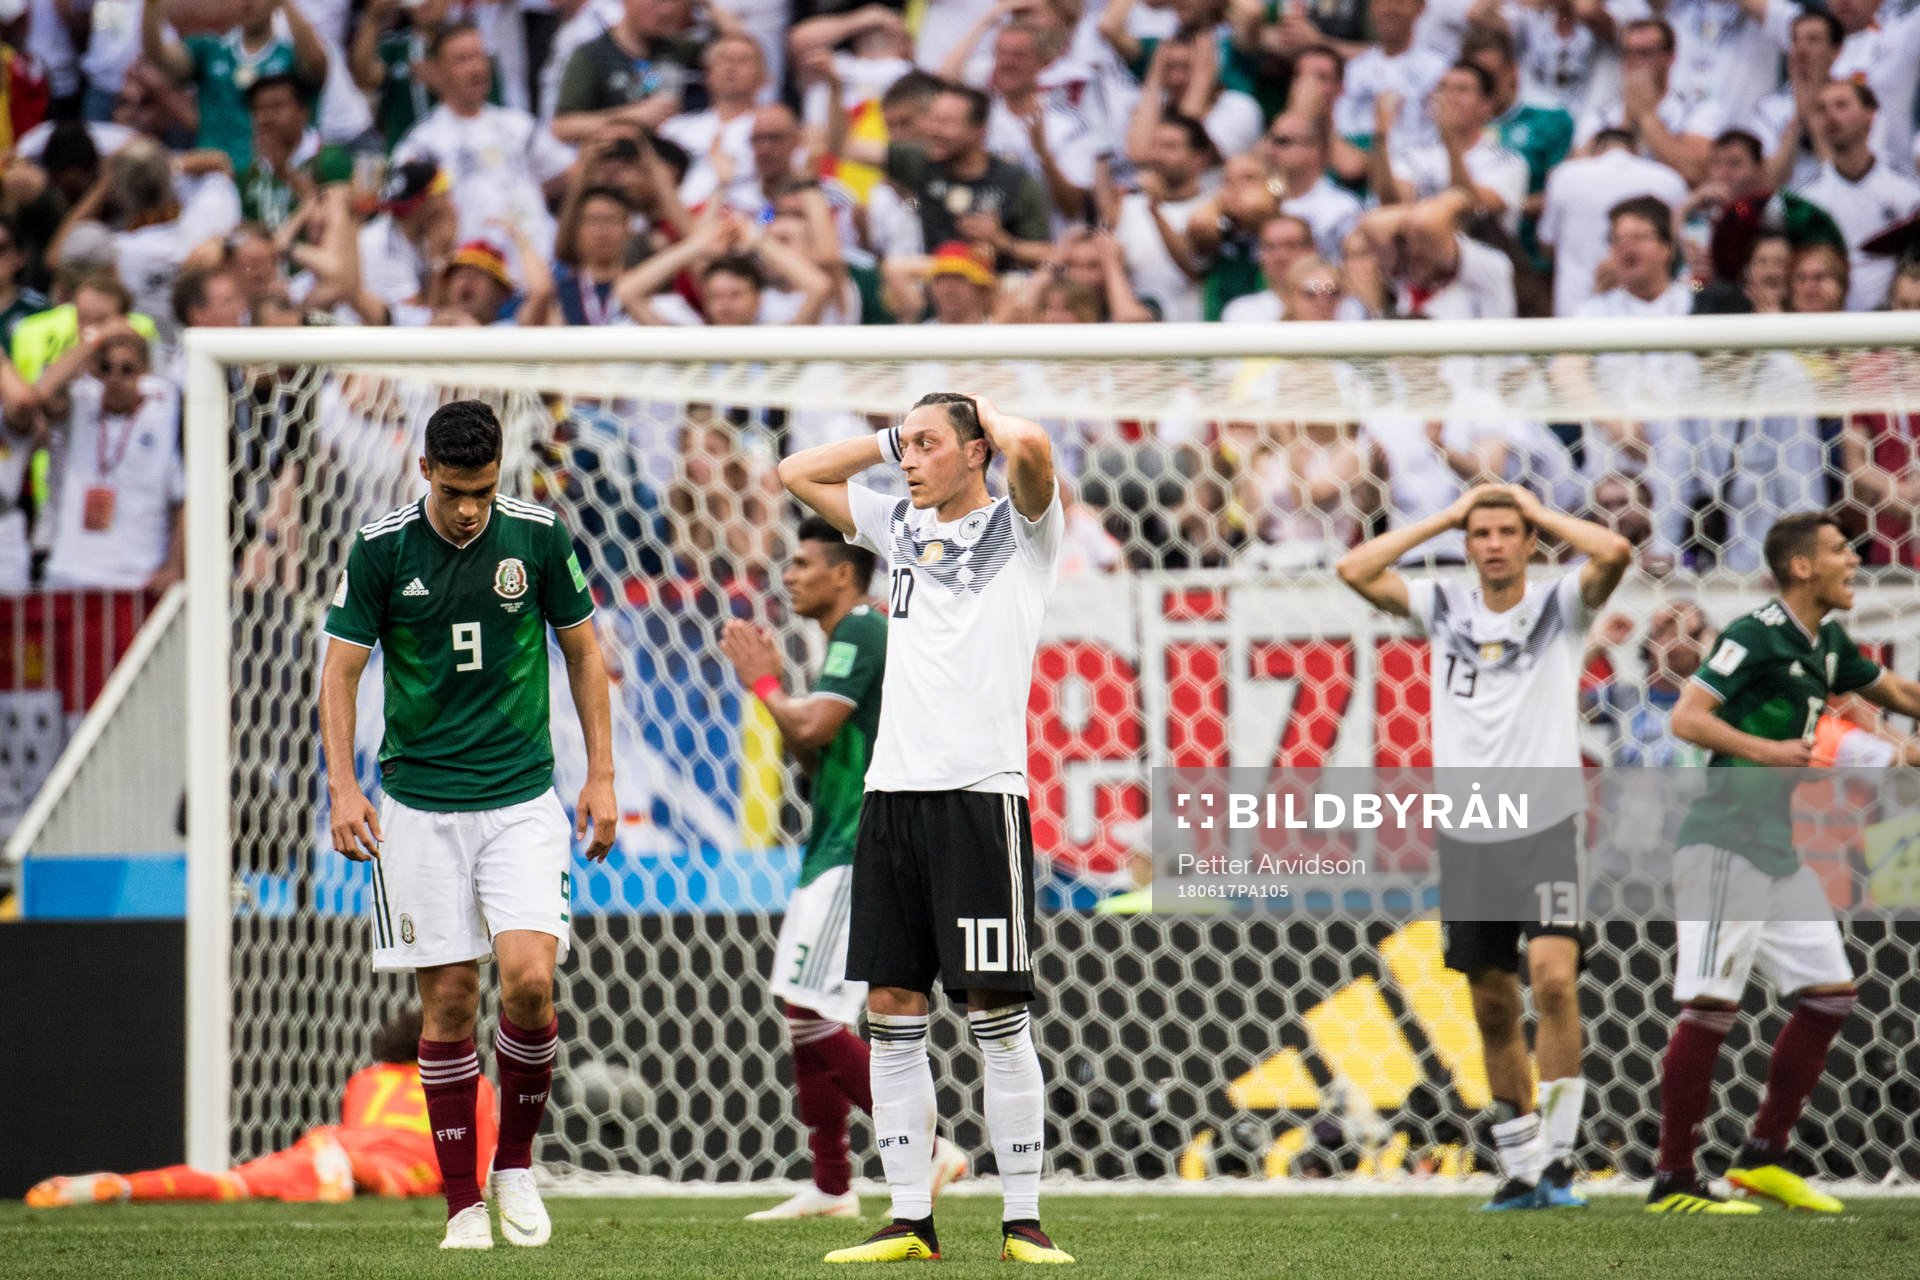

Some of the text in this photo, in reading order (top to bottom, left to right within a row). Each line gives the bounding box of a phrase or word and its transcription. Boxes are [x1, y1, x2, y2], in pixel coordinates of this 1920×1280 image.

[891, 567, 915, 618] 10
[452, 622, 482, 672] 9
[1446, 653, 1478, 698] 13
[1535, 881, 1578, 927] 13
[789, 943, 809, 985] 3
[957, 918, 1007, 972] 10
[519, 1091, 548, 1104] FMF
[436, 1127, 467, 1142] FMF
[878, 1135, 910, 1148] DFB
[1012, 1141, 1041, 1153] DFB
